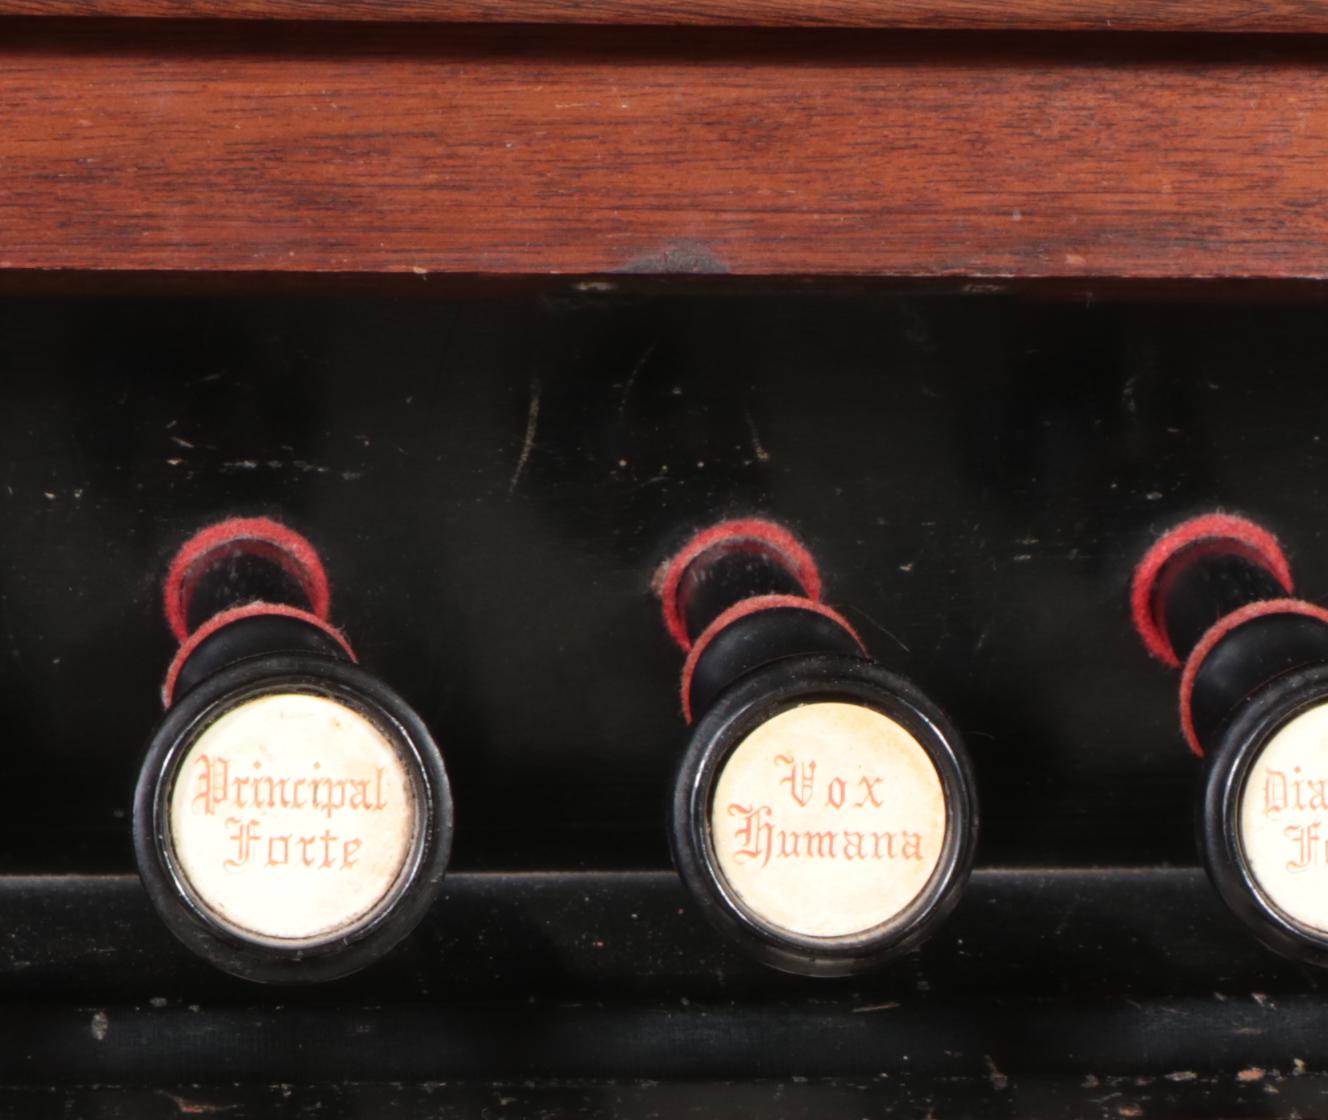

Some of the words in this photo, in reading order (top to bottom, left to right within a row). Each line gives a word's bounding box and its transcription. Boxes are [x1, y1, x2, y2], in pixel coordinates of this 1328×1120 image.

[192, 754, 387, 818] Principal
[774, 754, 885, 809] Vox
[223, 816, 363, 873] Forte
[728, 803, 925, 869] Humana
